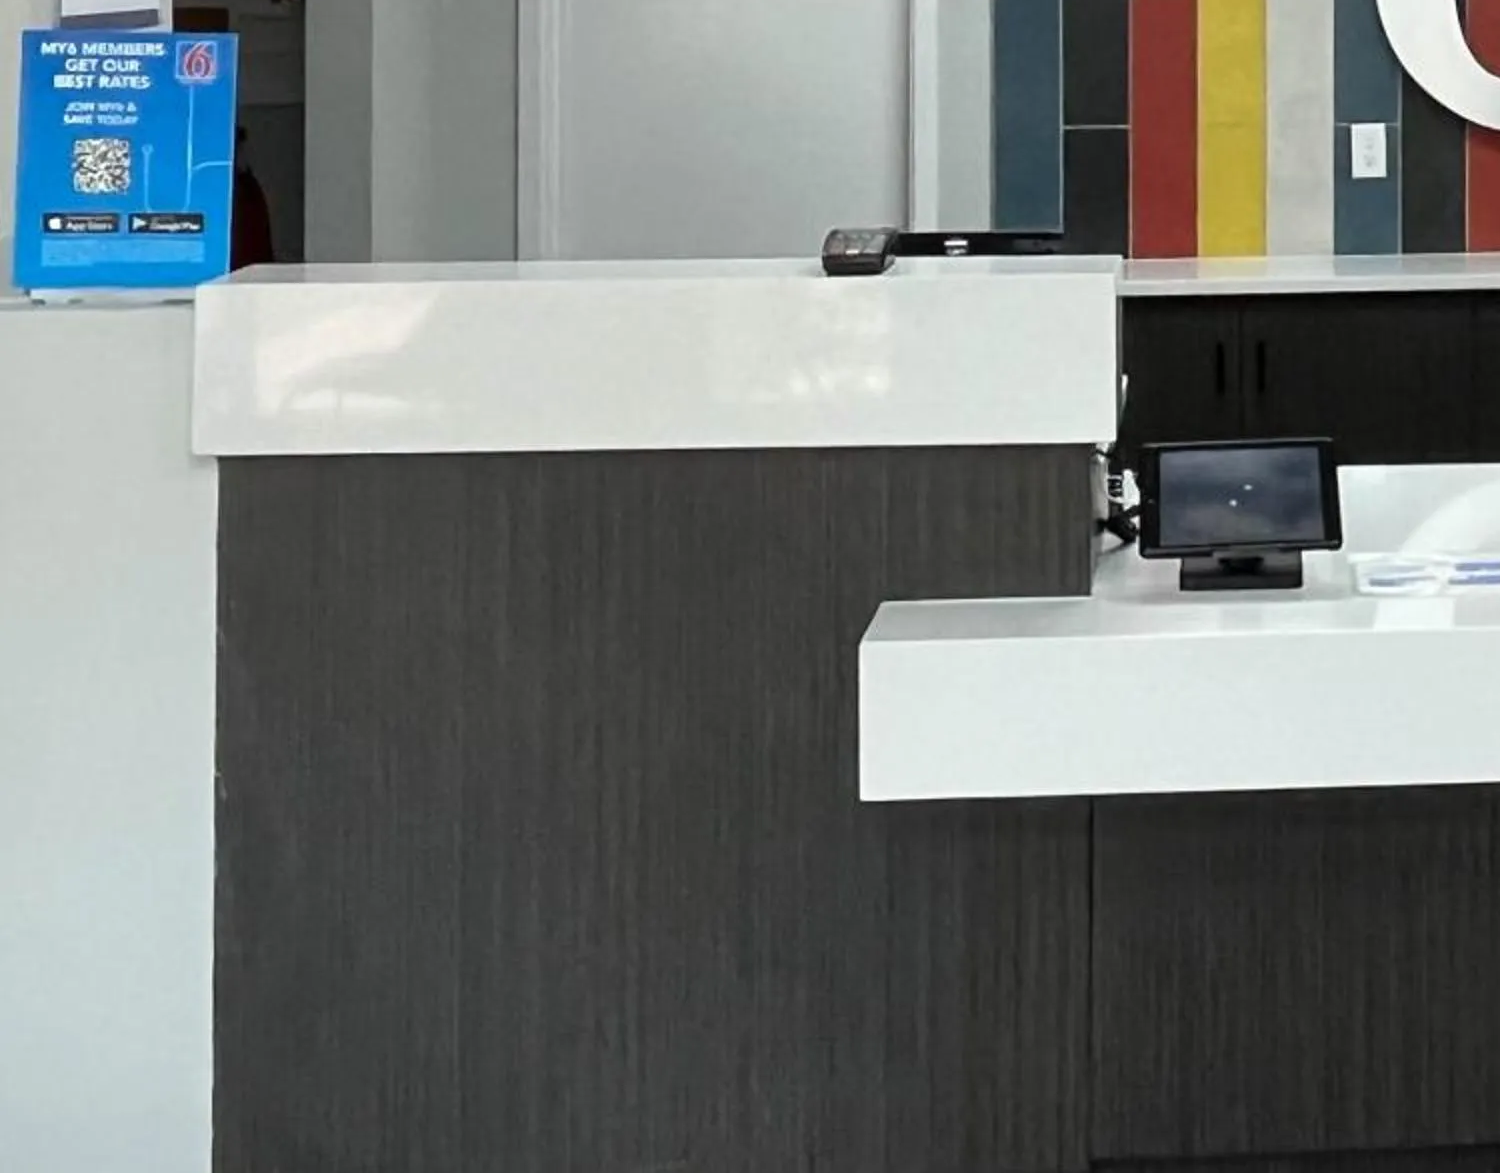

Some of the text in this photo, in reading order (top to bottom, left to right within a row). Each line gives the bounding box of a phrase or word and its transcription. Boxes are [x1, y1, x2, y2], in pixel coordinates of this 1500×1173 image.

[41, 42, 166, 56] MY6 MEMBERS
[65, 58, 140, 72] GET OUR
[183, 42, 214, 78] 6
[53, 74, 151, 89] BEST RATES
